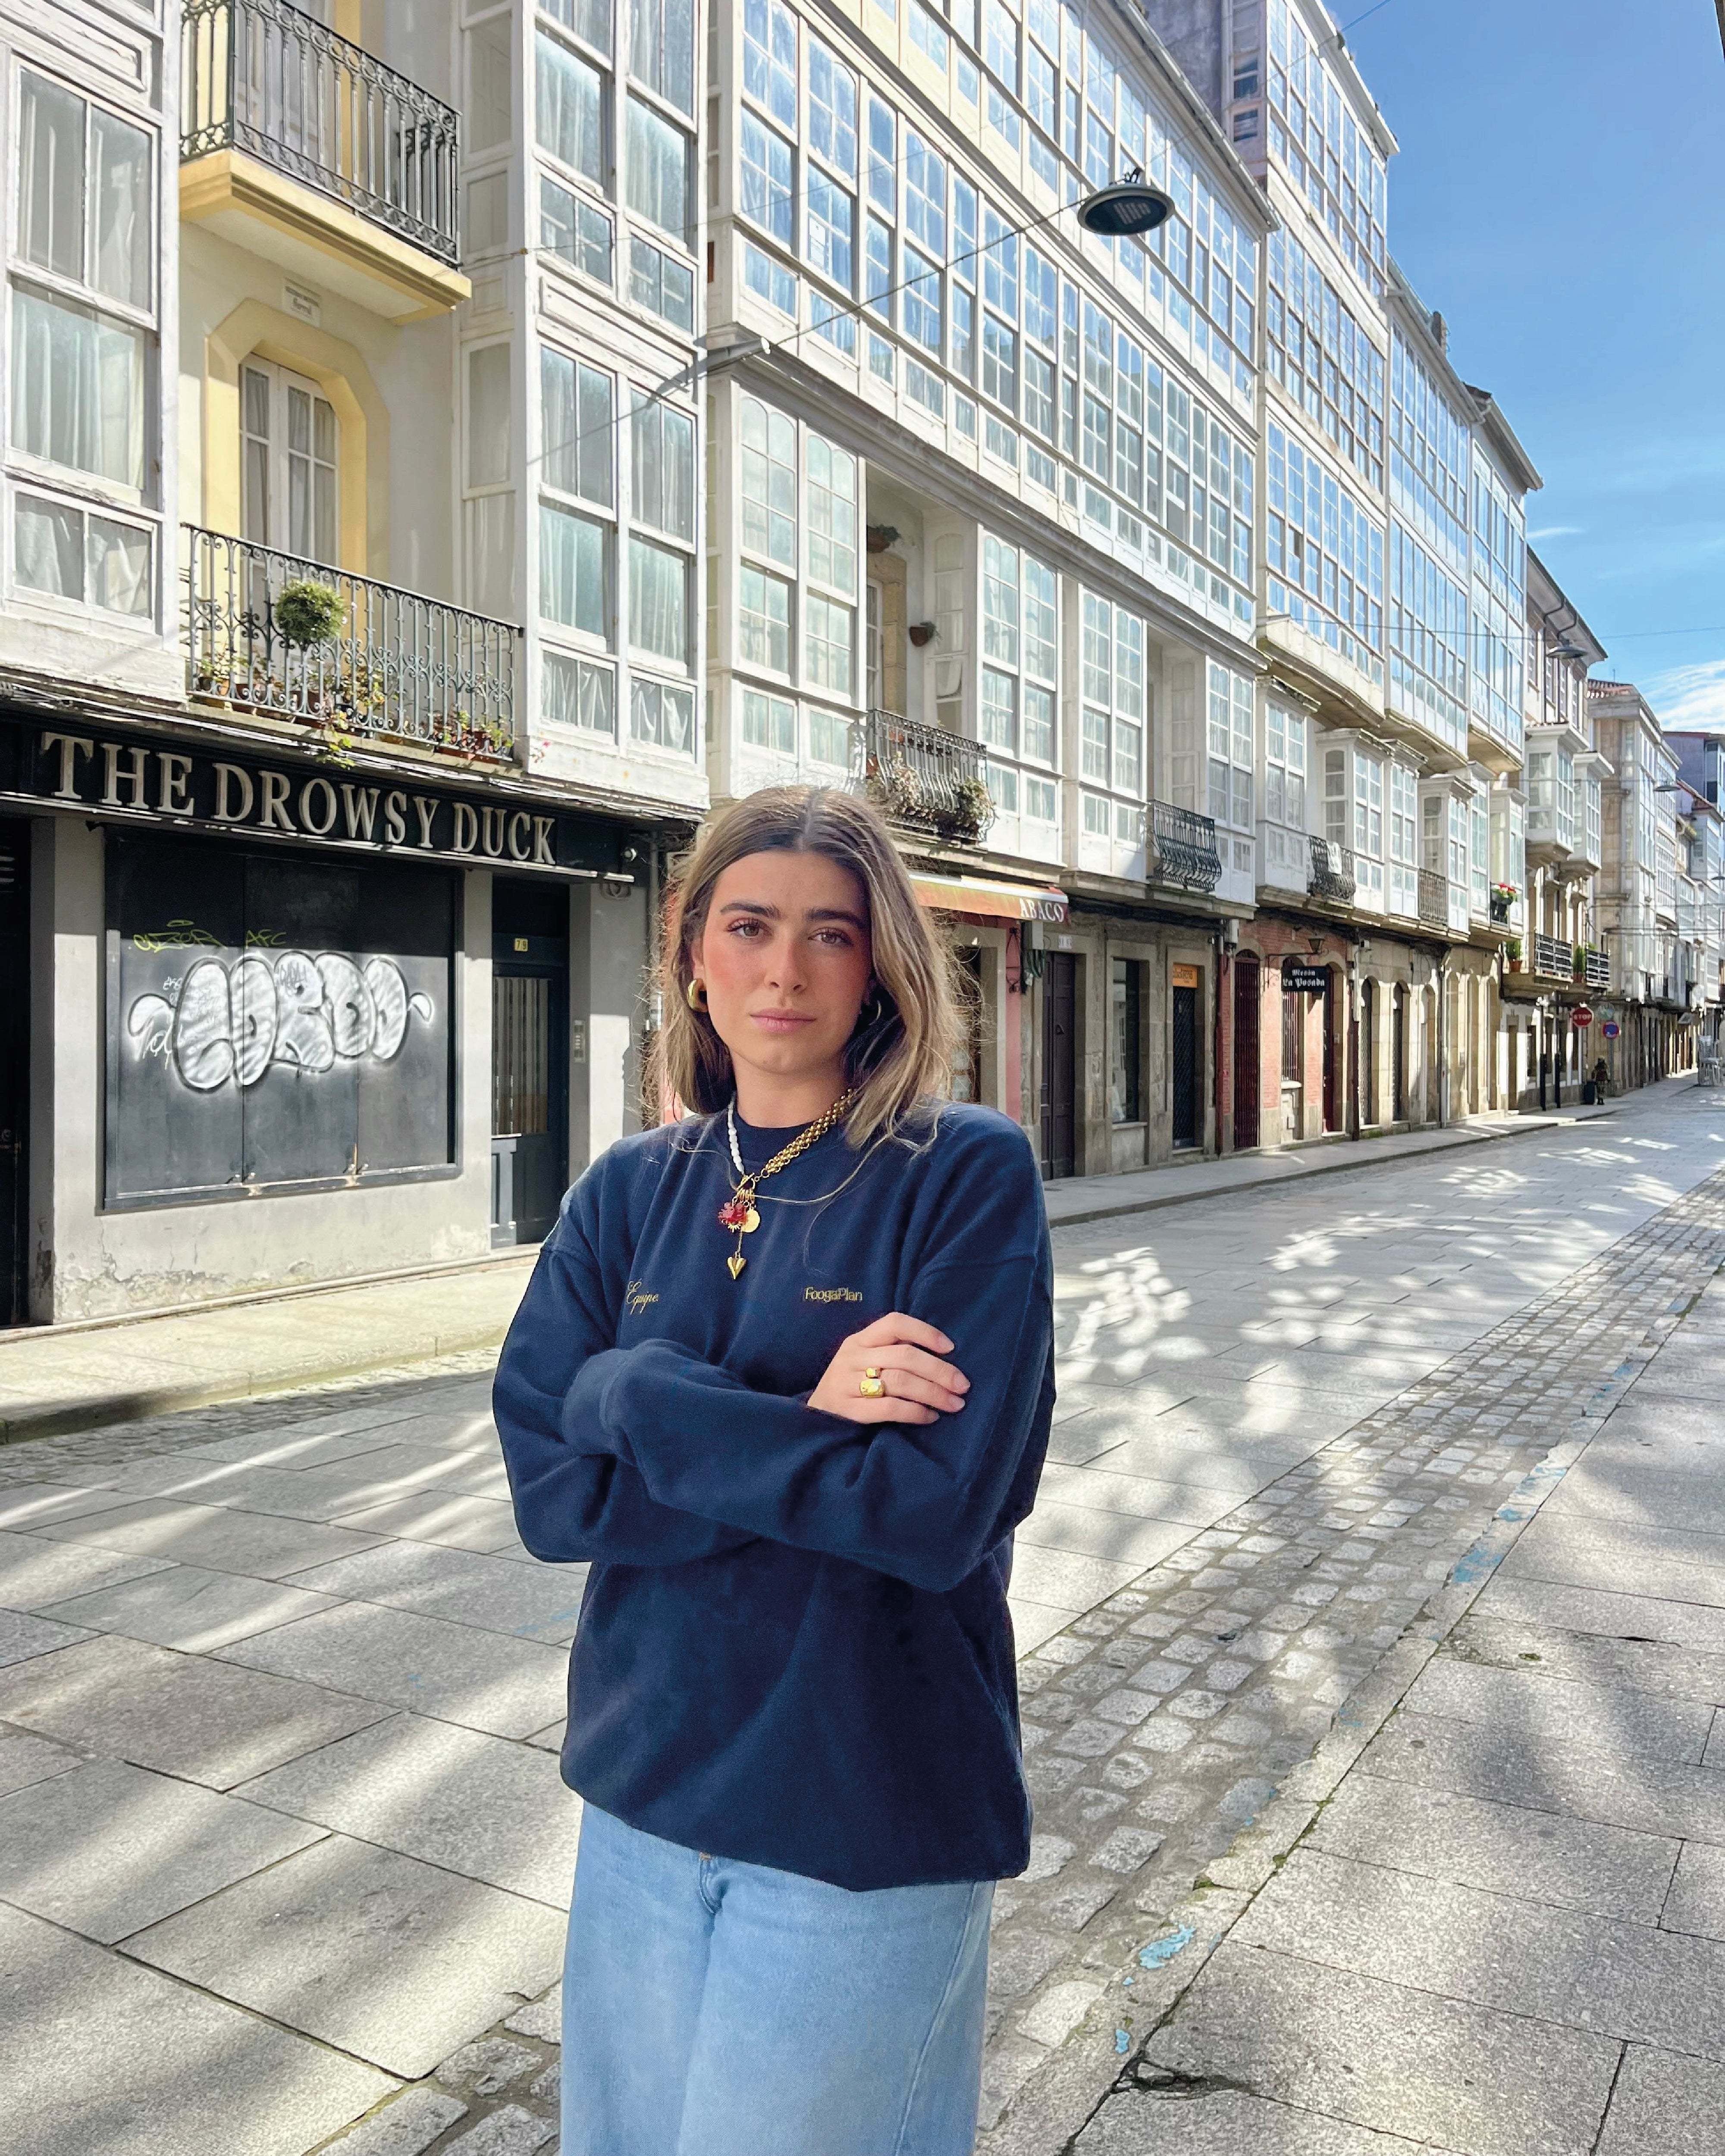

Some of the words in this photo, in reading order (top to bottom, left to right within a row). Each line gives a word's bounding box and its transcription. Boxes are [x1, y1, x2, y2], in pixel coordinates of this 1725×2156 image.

[41, 732, 194, 816] THE
[211, 762, 440, 849] DROWSY
[451, 802, 555, 865] DUCK
[1019, 897, 1064, 922] ABACO
[517, 940, 527, 950] 79
[1295, 978, 1325, 988] Posada
[805, 1287, 863, 1303] FoogaPlan
